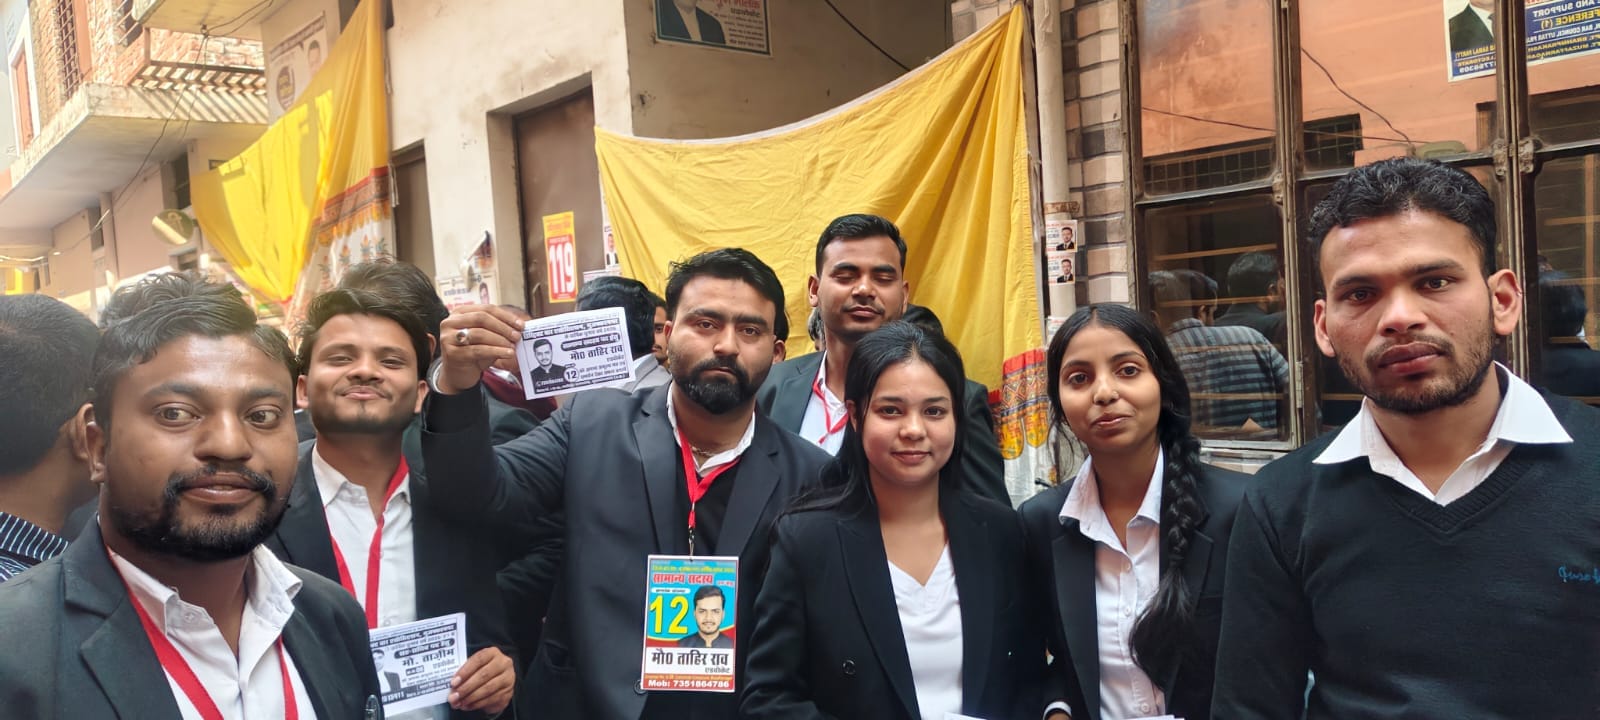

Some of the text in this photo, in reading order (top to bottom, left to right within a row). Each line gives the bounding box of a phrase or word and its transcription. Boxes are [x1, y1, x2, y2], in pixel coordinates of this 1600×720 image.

[549, 242, 576, 294] 119
[588, 347, 608, 358] ताहिर
[610, 345, 623, 354] राव
[566, 370, 577, 380] 12
[650, 594, 690, 634] 12
[677, 649, 708, 666] ताहिर
[710, 652, 730, 666] राव
[648, 680, 730, 688] Mob: 7351864786
